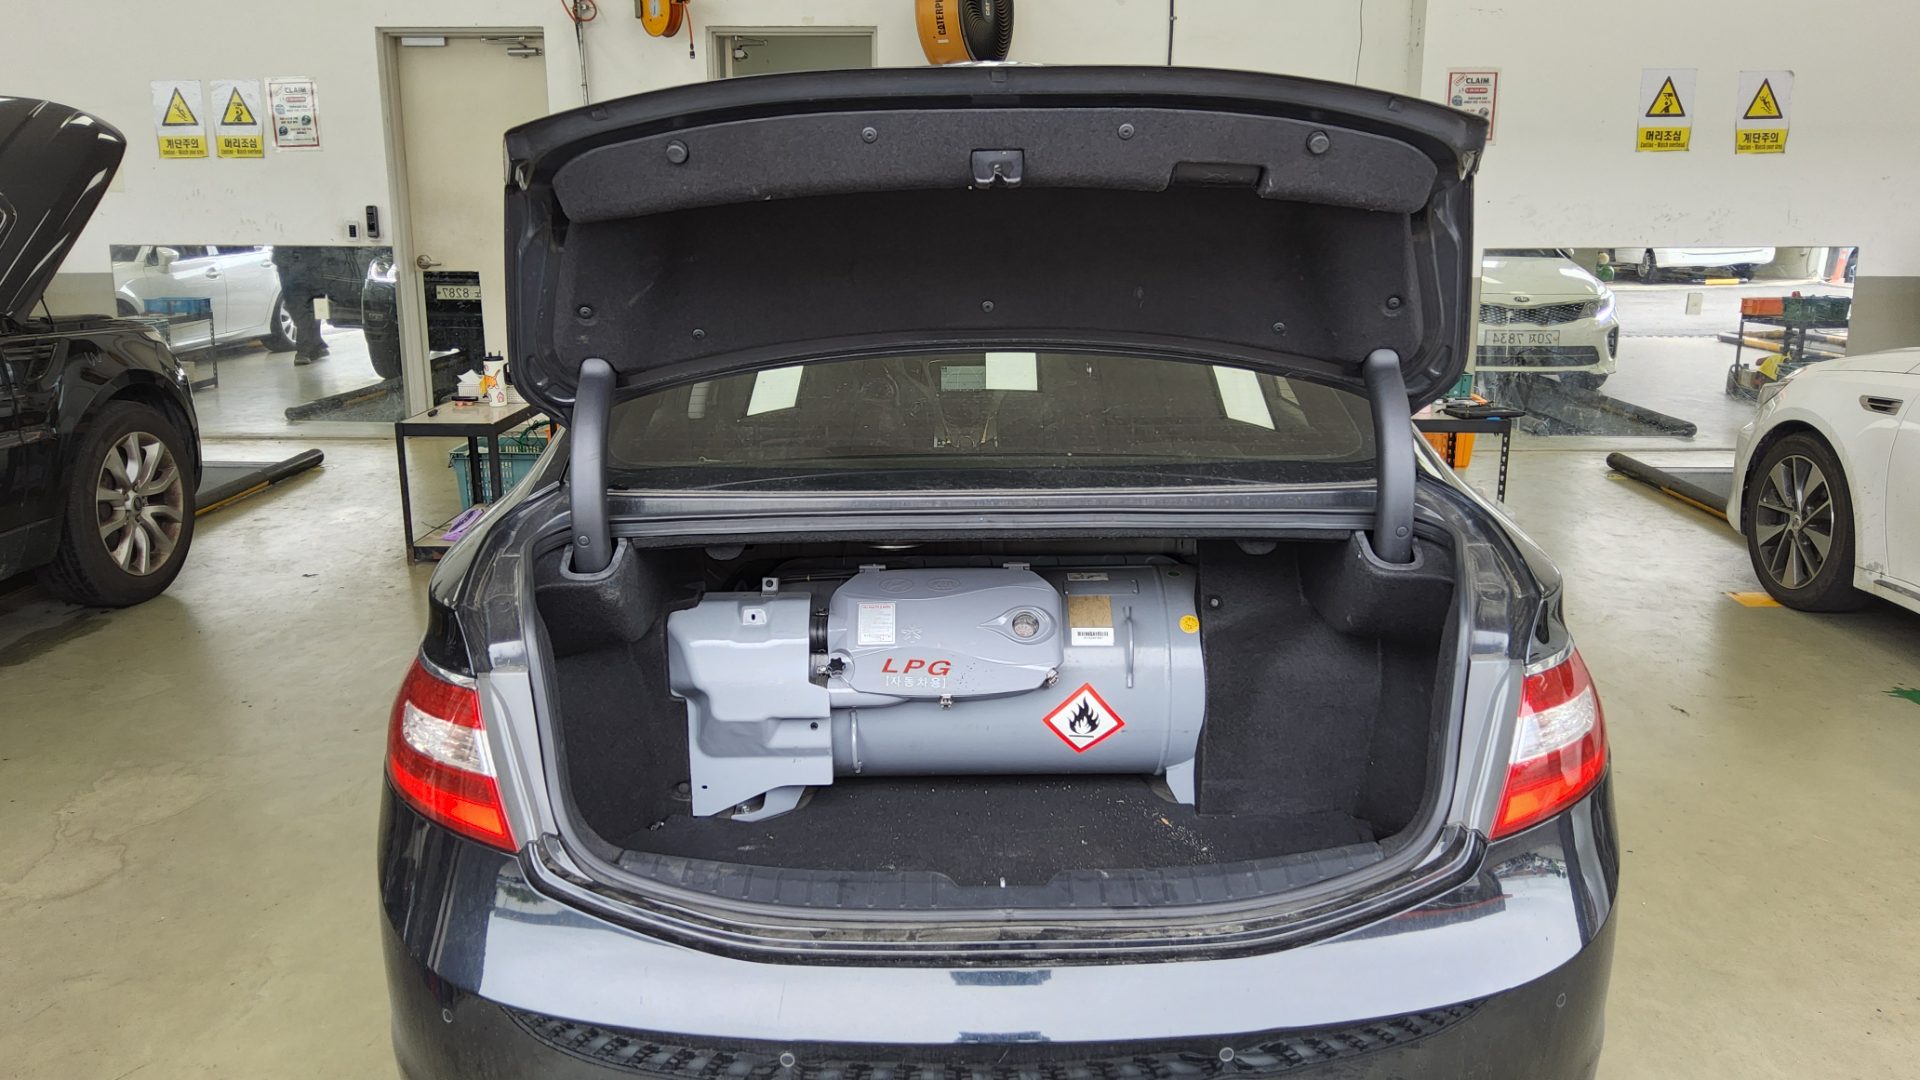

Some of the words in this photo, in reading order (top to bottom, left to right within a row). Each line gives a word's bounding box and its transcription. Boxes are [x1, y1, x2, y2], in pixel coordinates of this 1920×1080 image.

[1645, 130, 1682, 142] 머리조심
[1743, 131, 1779, 144] 계단주의
[166, 138, 199, 149] 계단주의
[224, 138, 258, 148] 머리조심
[881, 657, 952, 676] LPG
[885, 675, 947, 689] [자동차용]
